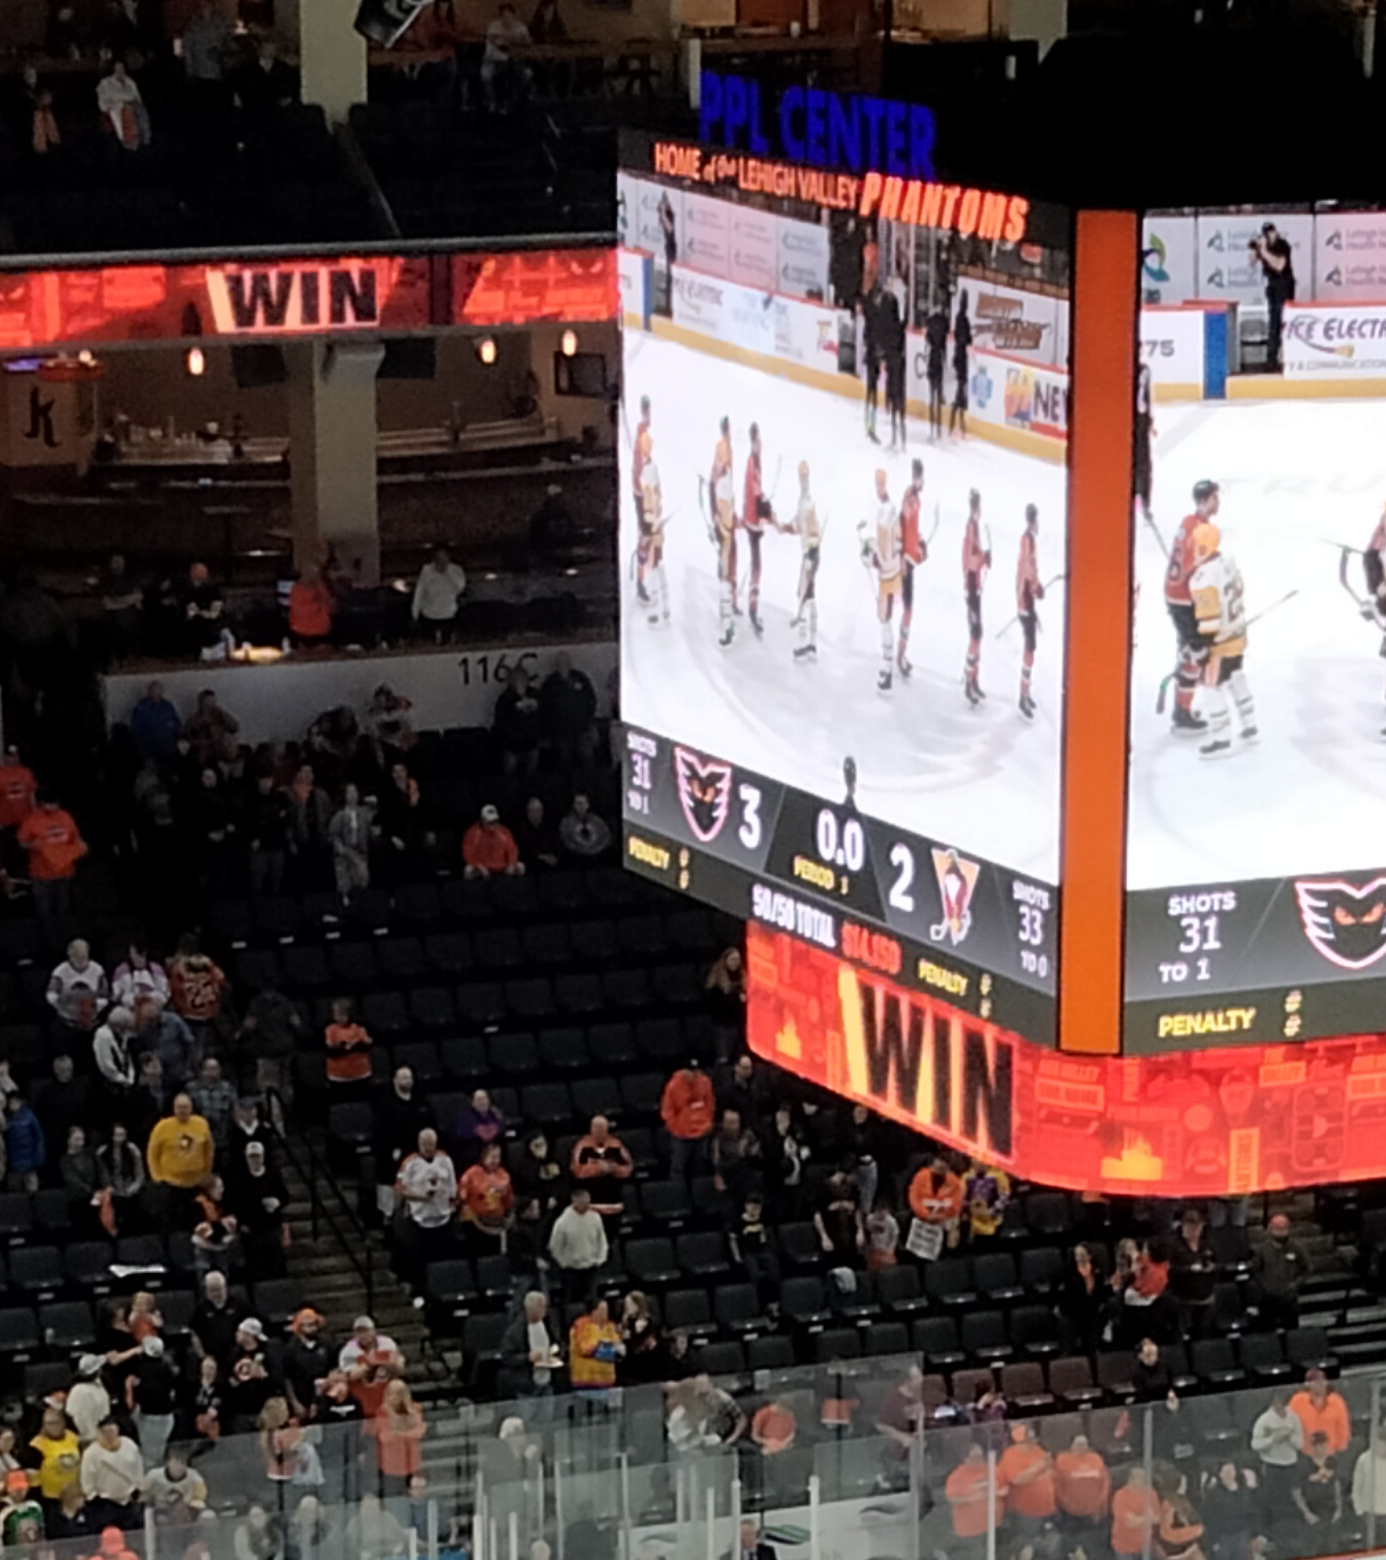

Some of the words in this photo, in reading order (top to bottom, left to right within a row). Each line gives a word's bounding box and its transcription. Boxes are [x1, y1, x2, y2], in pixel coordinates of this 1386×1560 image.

[699, 69, 769, 155] PPL
[779, 84, 936, 181] CENTER
[654, 142, 701, 180] HOME
[738, 156, 794, 197] LEHIGH
[798, 170, 859, 212] VALLEY
[859, 171, 1030, 243] PHANTOMS
[225, 268, 379, 329] WIN
[631, 753, 652, 790] 31
[739, 784, 761, 849] 3
[817, 809, 864, 871] 0.0
[889, 843, 914, 912] 2
[796, 899, 836, 948] TOTAL
[1018, 906, 1044, 946] 33
[1167, 891, 1236, 916] SHOTS
[1179, 916, 1221, 953] 31
[917, 958, 969, 997] PENALTY
[1159, 963, 1188, 984] TO
[1196, 958, 1211, 981] 1
[1158, 1007, 1257, 1038] PENALTY
[859, 985, 1014, 1161] WIN
